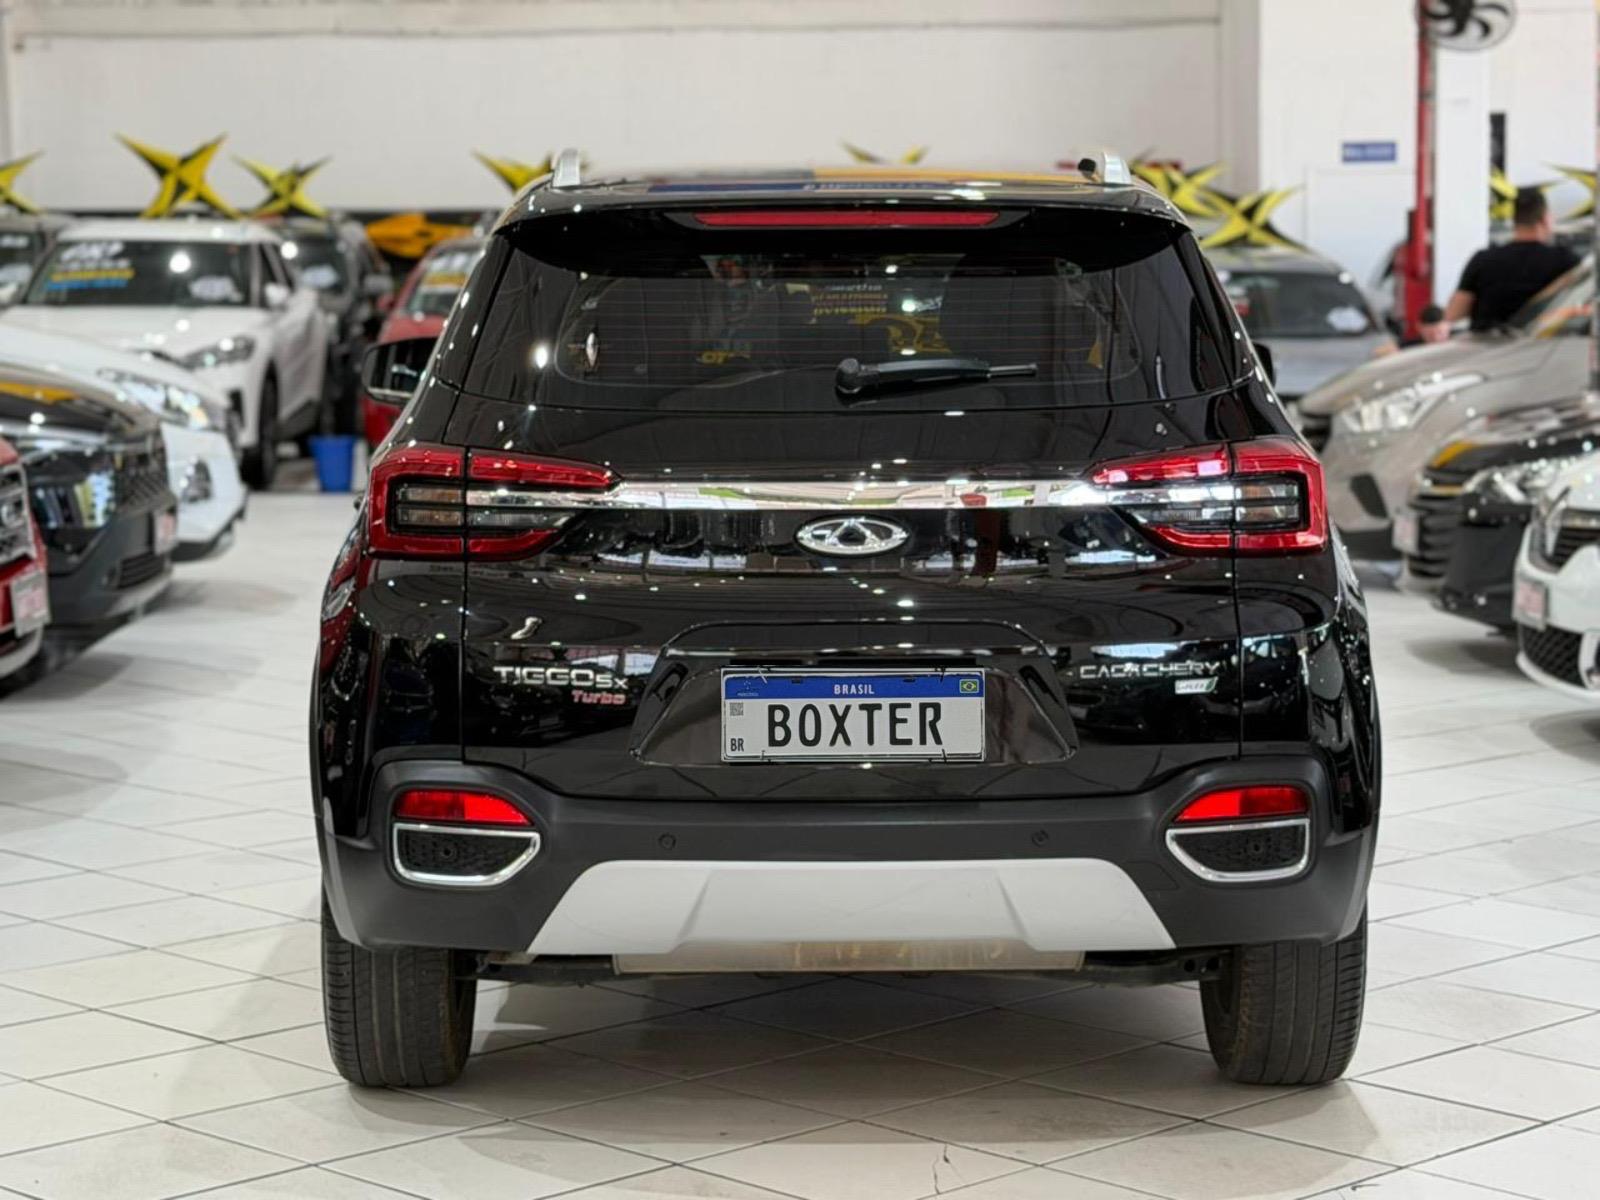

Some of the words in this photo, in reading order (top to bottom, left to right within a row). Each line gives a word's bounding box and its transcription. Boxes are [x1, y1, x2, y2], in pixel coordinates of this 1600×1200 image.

[1142, 659, 1221, 677] CHERY
[833, 683, 876, 695] BRASIL
[571, 690, 626, 705] Turbo
[767, 702, 943, 748] BOXTER
[730, 738, 745, 752] BR
